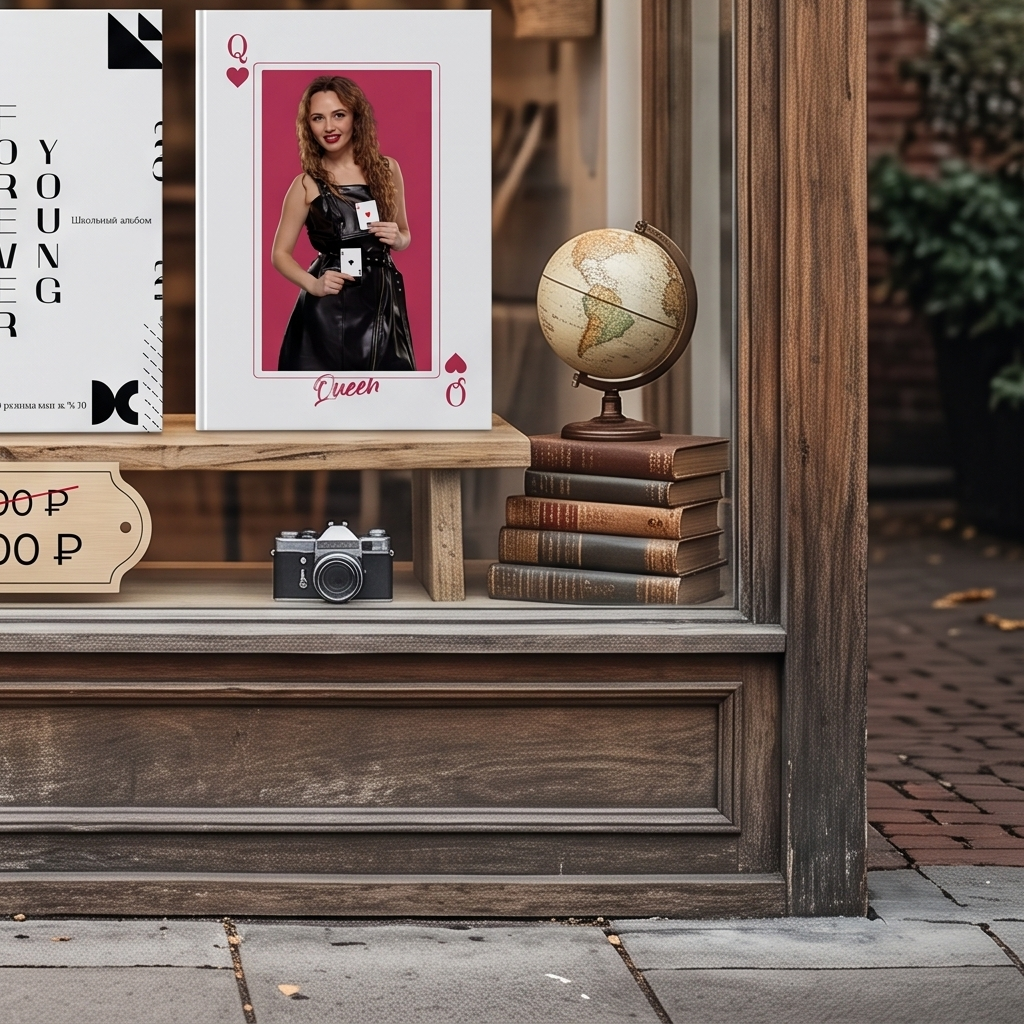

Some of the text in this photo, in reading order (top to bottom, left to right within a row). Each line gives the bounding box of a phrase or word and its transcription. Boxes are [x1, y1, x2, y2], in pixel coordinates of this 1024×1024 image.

[227, 33, 248, 64] Q
[35, 139, 61, 304] YOUNG
[312, 373, 380, 408] Queen
